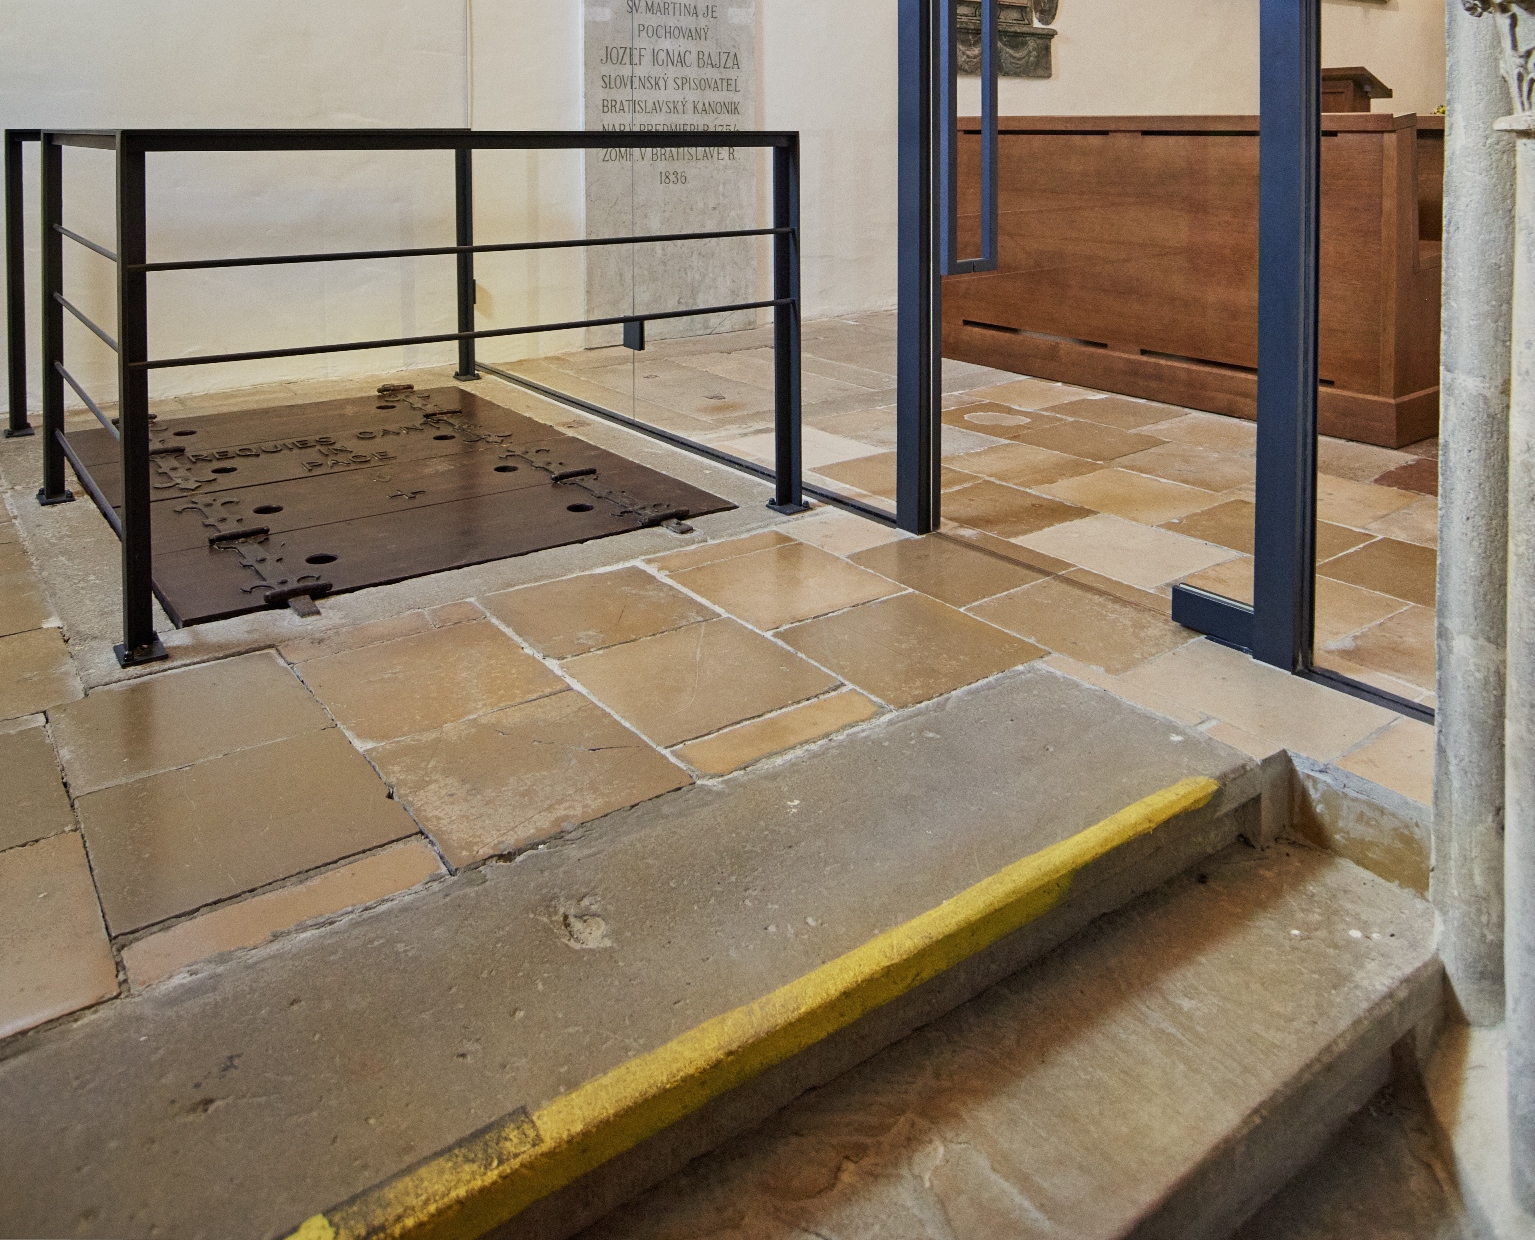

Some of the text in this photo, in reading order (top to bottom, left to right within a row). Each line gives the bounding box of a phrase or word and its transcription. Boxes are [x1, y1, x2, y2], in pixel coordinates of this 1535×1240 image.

[645, 0, 699, 18] MARTINA
[702, 4, 718, 19] JE
[637, 23, 709, 41] POCHOVANÝ
[600, 44, 741, 69] JOZEF IGNÁC BAJZA
[601, 72, 669, 90] SLOVENSKÝ
[601, 97, 740, 115] BRATISLAVSKÝ KANONIK
[651, 147, 725, 161] BRATISLAVE
[186, 436, 337, 464] REQUIES
[317, 445, 353, 457] IN
[300, 450, 398, 472] PACE
